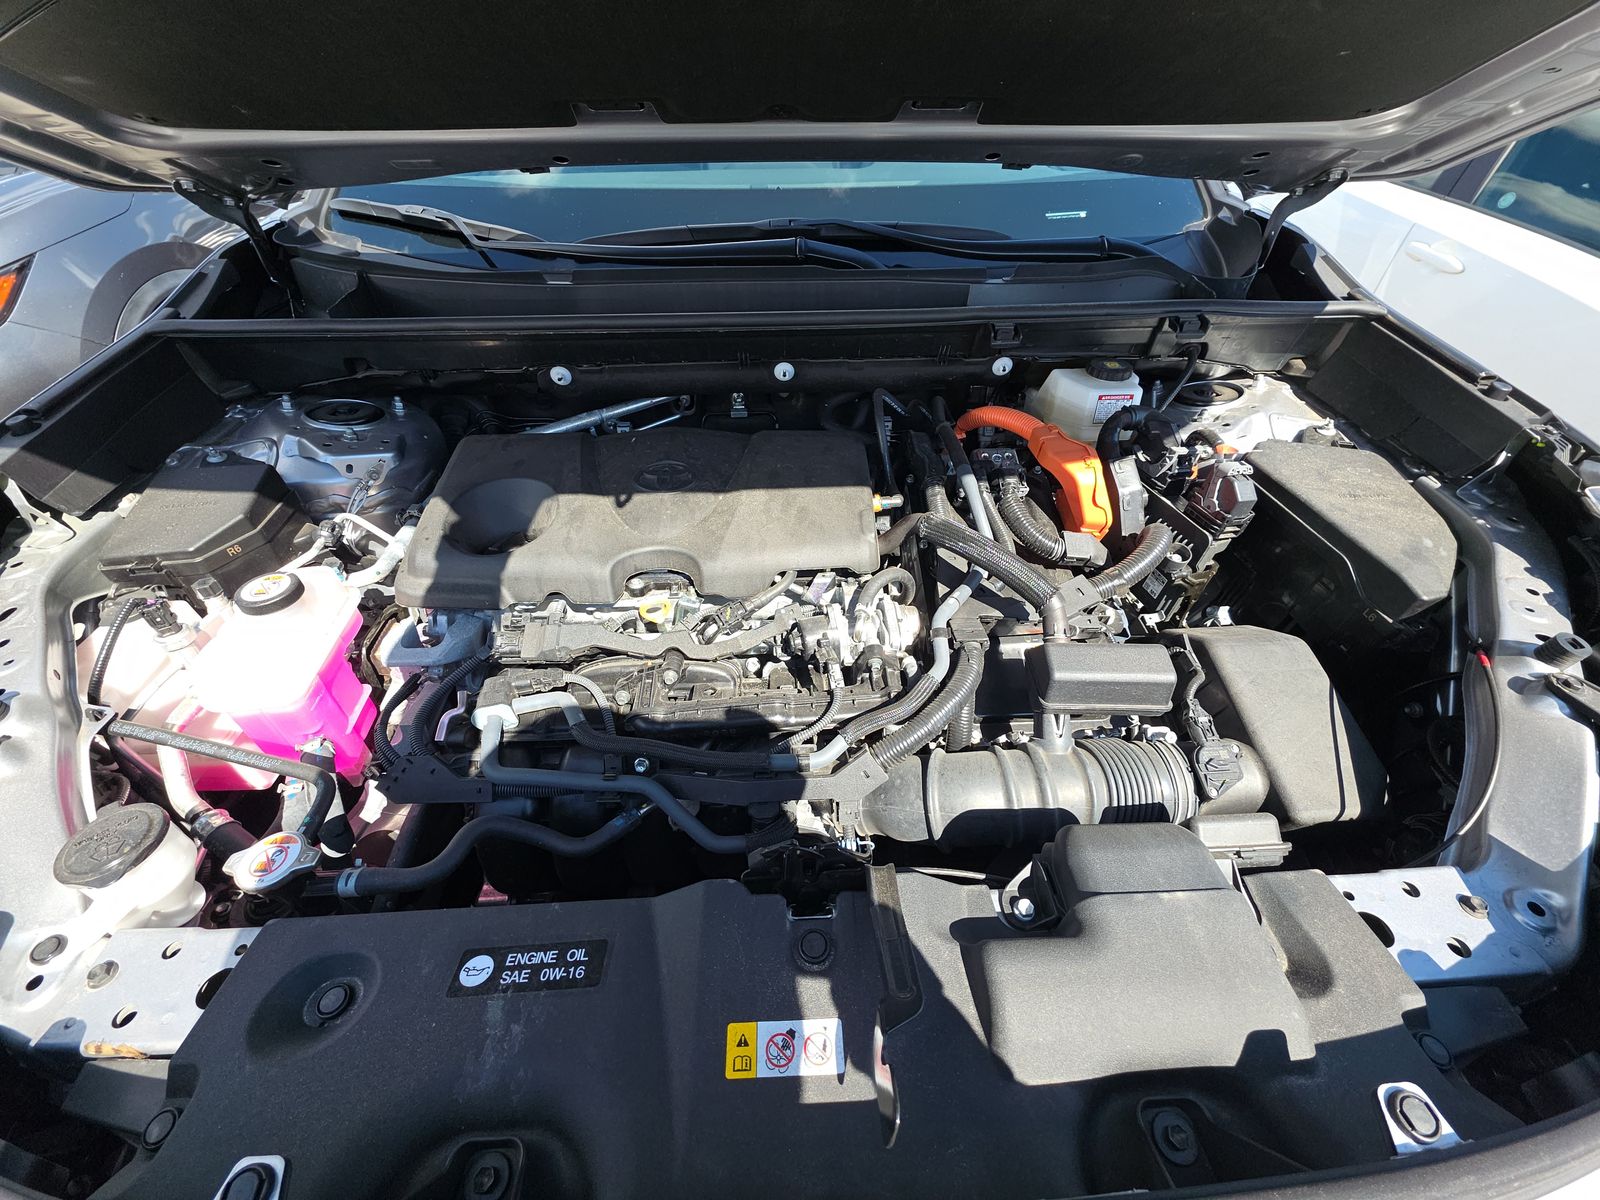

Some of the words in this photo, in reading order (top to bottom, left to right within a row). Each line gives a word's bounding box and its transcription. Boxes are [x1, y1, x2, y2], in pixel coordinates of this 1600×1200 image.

[226, 544, 242, 557] R6
[1362, 607, 1377, 622] L6
[505, 950, 558, 966] ENGINE
[566, 948, 589, 962] OIL
[499, 969, 531, 984] SAE
[540, 966, 585, 981] 0W-16
